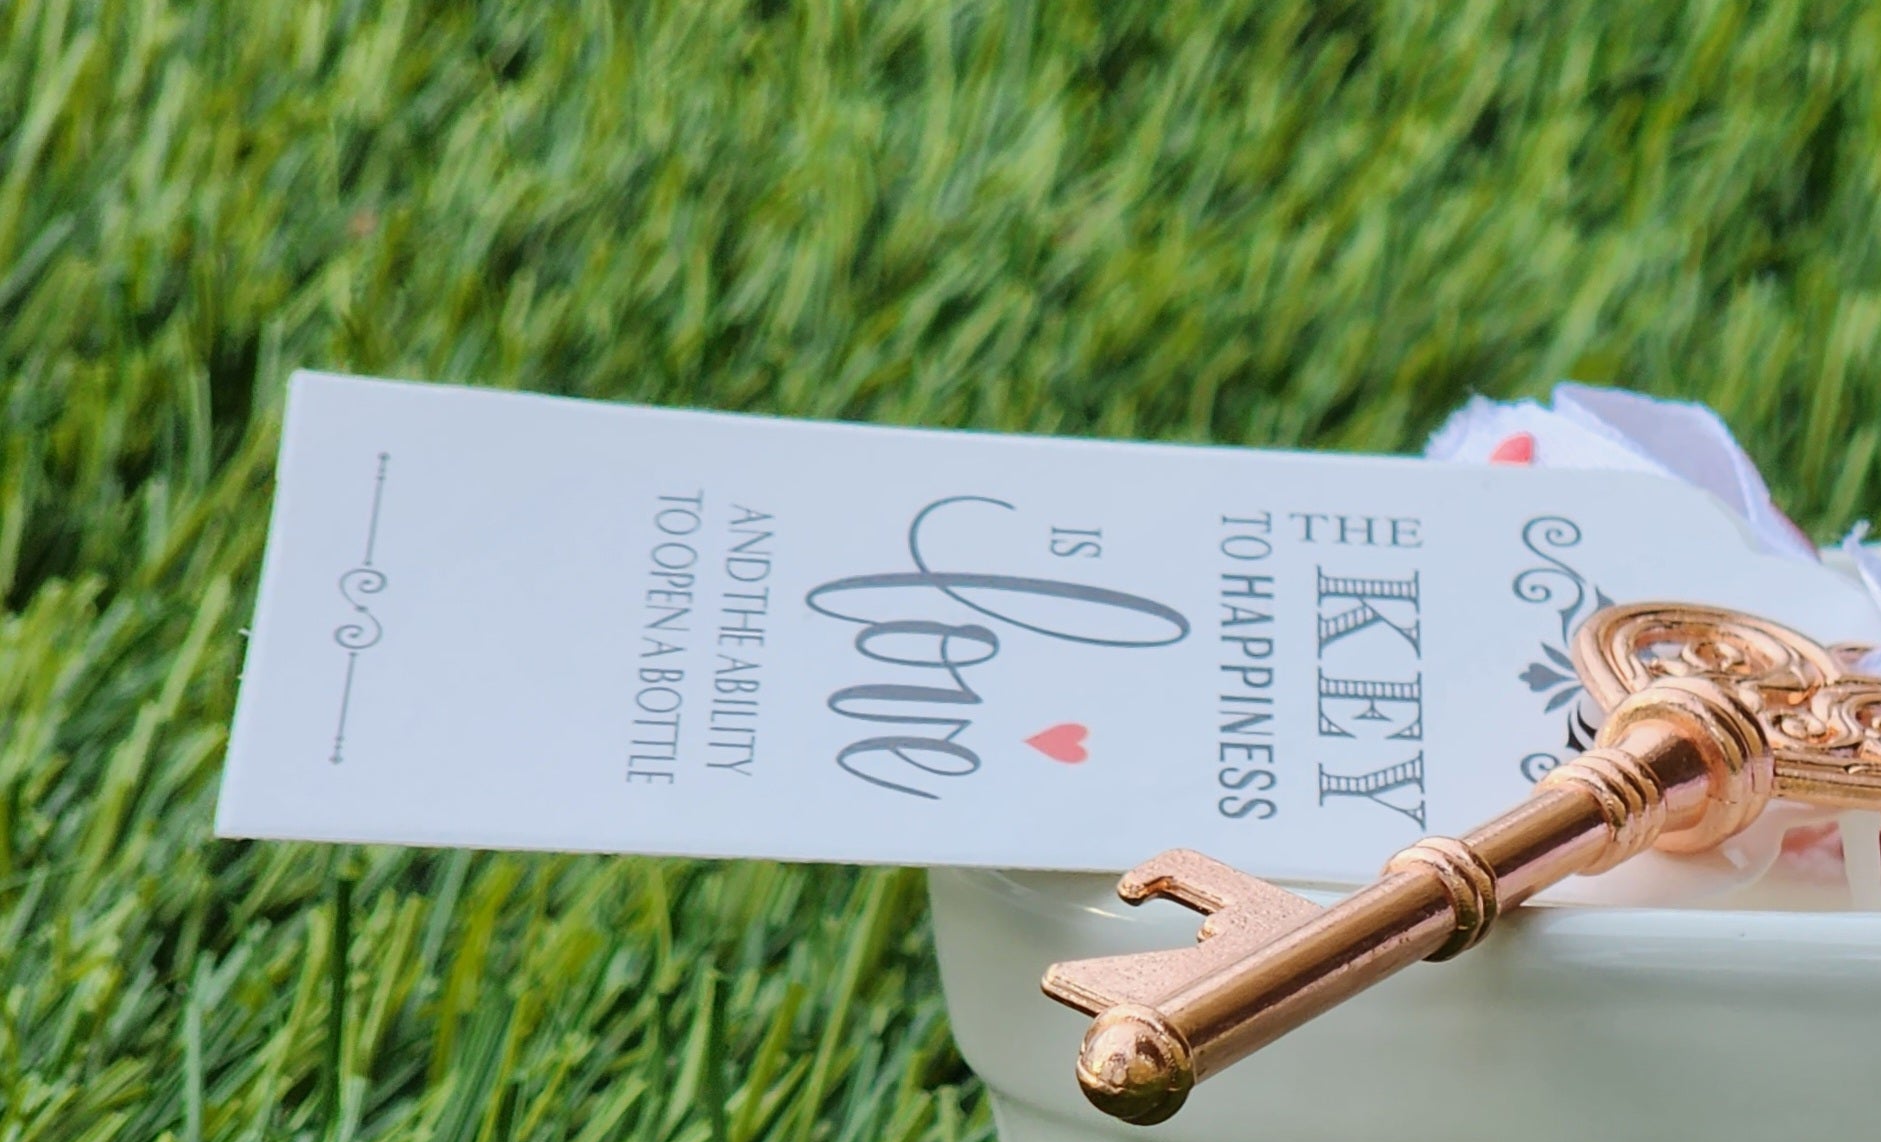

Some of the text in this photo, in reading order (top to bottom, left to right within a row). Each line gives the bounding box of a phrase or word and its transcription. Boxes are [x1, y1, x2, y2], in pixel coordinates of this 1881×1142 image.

[626, 489, 704, 786] TO OPEN A BOTTLE
[706, 502, 774, 777] AND THE ABILITY
[805, 495, 1191, 800] love
[1050, 526, 1102, 558] IS
[1218, 511, 1277, 820] TO HAPPINESS
[1289, 511, 1424, 548] THE
[1316, 564, 1426, 831] KEY
